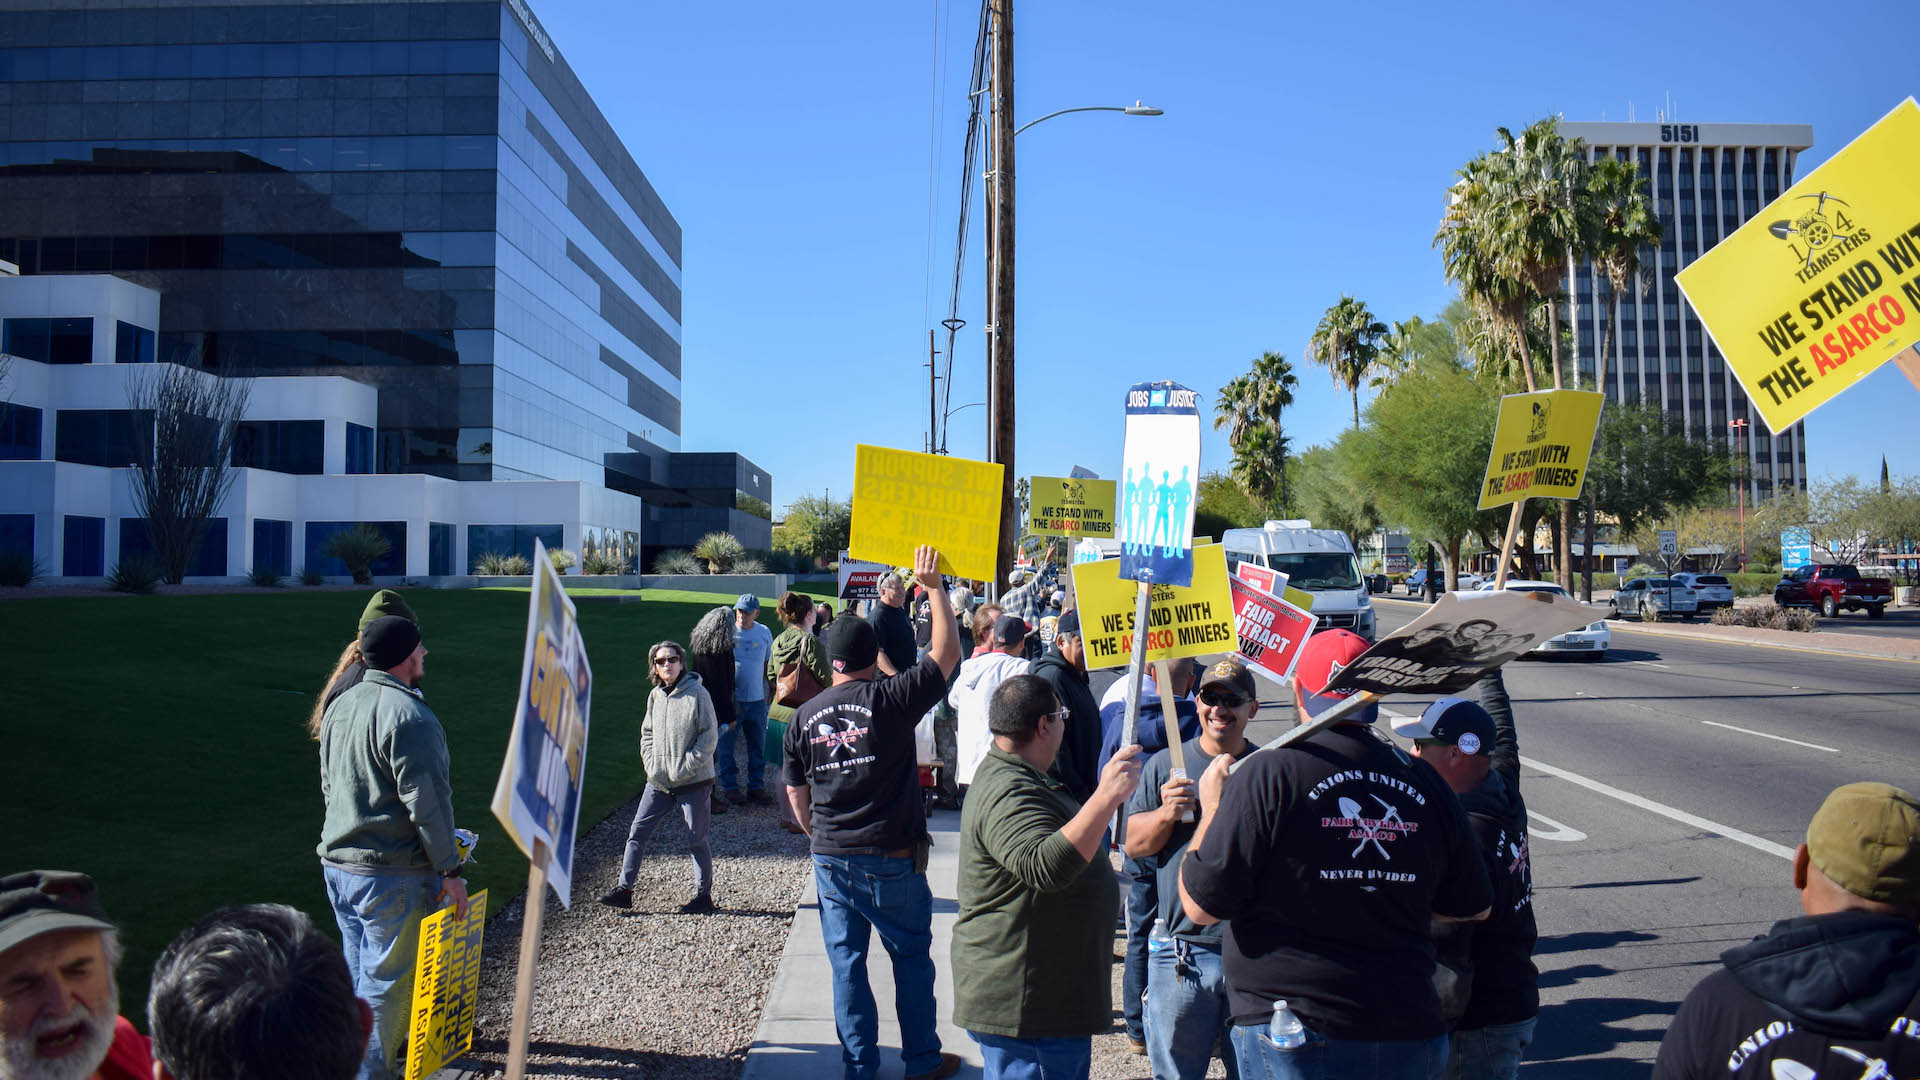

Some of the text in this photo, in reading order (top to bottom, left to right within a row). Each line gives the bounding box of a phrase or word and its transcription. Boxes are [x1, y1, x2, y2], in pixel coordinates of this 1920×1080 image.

[1661, 125, 1699, 142] 5151
[1795, 227, 1871, 284] TEAMSTERS
[1757, 311, 1806, 357] WE
[1799, 259, 1883, 331] STAND
[1757, 295, 1906, 406] THE ASARCO
[1127, 391, 1149, 407] JOBS
[1166, 390, 1197, 408] JUSTICE
[1501, 452, 1516, 472] WE
[1539, 445, 1570, 463] WITH
[1487, 476, 1505, 496] THE
[1533, 467, 1579, 487] MINERS
[1033, 519, 1111, 532] THE ASARCO MINERS
[1042, 507, 1103, 519] WE STAND WITH
[1663, 544, 1674, 552] 40
[1132, 591, 1176, 605] TSTERS
[1101, 601, 1212, 633] WE SND WITH
[1240, 599, 1276, 628] FAIR
[1090, 622, 1230, 657] THE ARCO MINERS
[1234, 613, 1290, 655] NTRACT
[803, 704, 873, 731] UNIONS UNITED
[815, 755, 876, 772] NEVER DIVIDED
[1308, 770, 1425, 805] UNIONS UNITED
[1321, 817, 1418, 832] FAIR CONTRACT
[1348, 829, 1397, 841] ASARCO
[1320, 869, 1364, 879] NEVER
[430, 912, 454, 1021] ON STRIKE
[455, 895, 485, 1053] WE SUPPORT
[412, 922, 438, 1079] AGAINST ASARCO
[1728, 1021, 1794, 1072] UNIO
